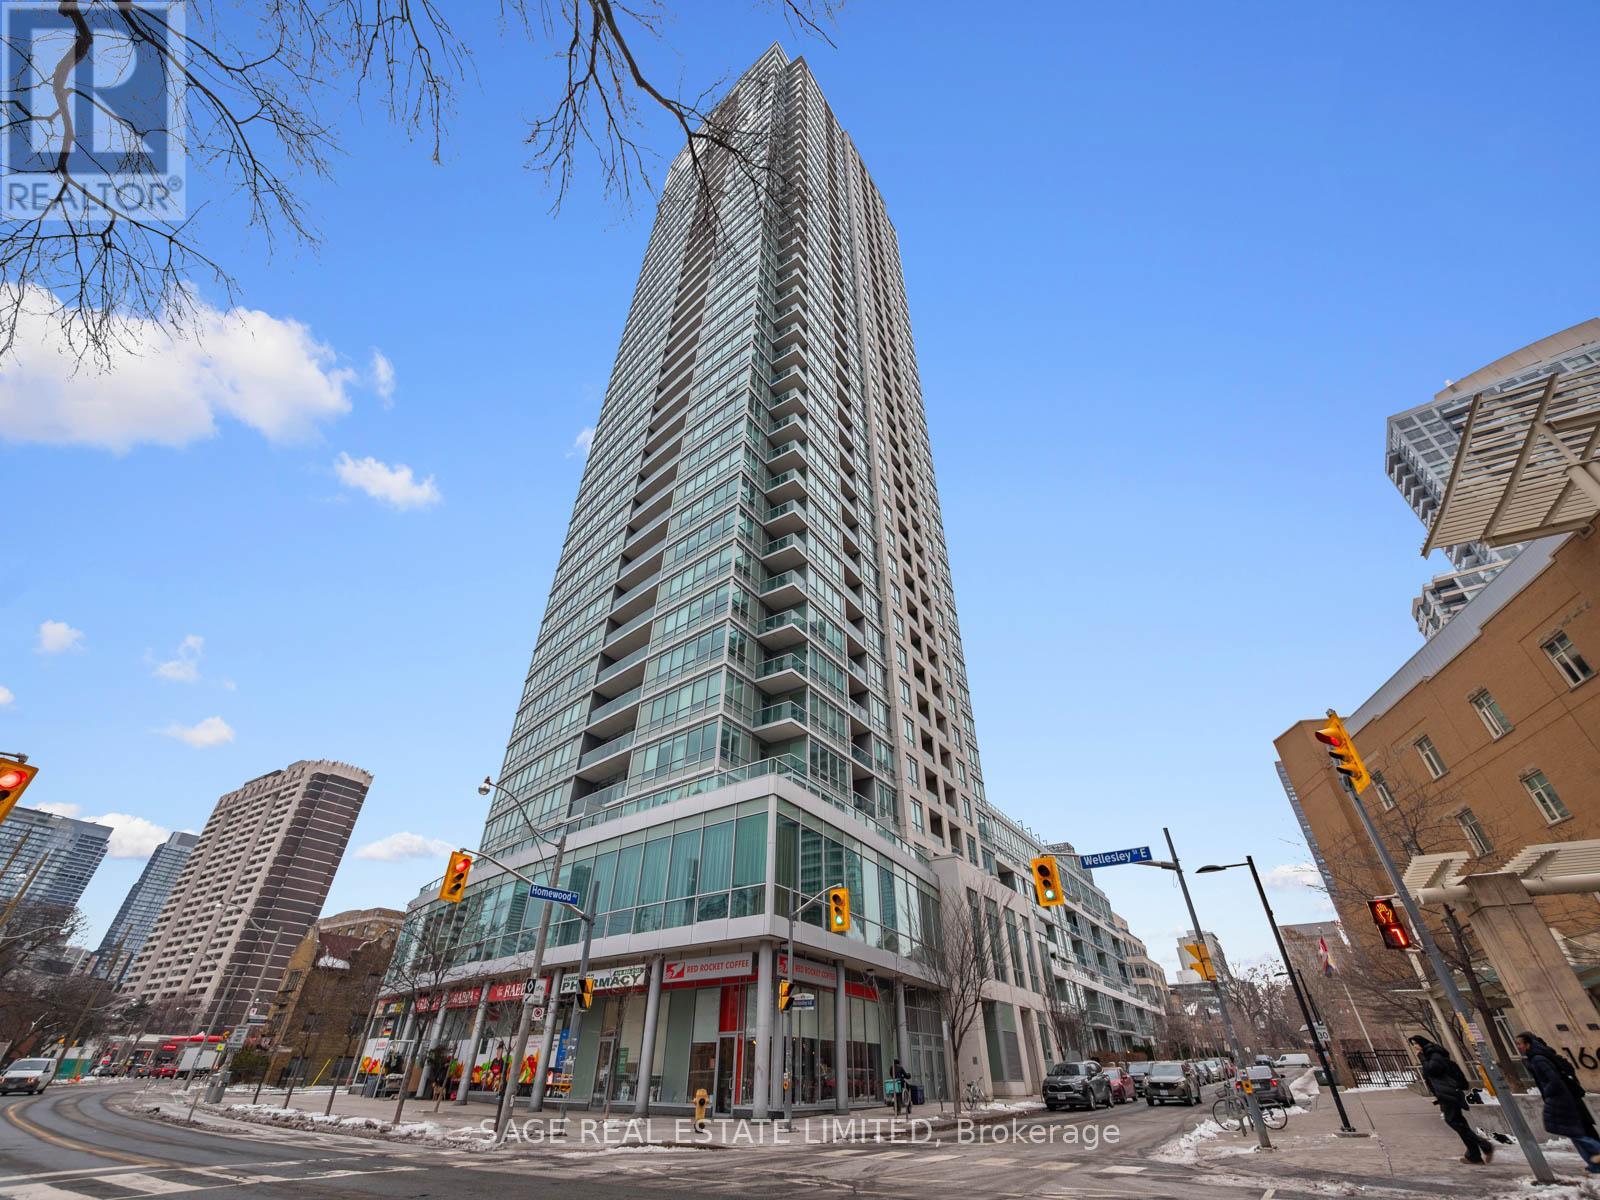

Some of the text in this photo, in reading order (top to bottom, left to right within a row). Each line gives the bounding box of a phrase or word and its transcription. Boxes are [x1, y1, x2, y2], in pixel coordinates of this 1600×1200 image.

[1083, 852, 1131, 866] Wellesley
[1140, 847, 1148, 858] E
[531, 885, 571, 901] Homewood
[687, 959, 749, 974] RED ROCKET COFFEE
[561, 974, 641, 991] PHRMACY
[1318, 1031, 1329, 1040] 30
[1561, 1047, 1600, 1070] 16
